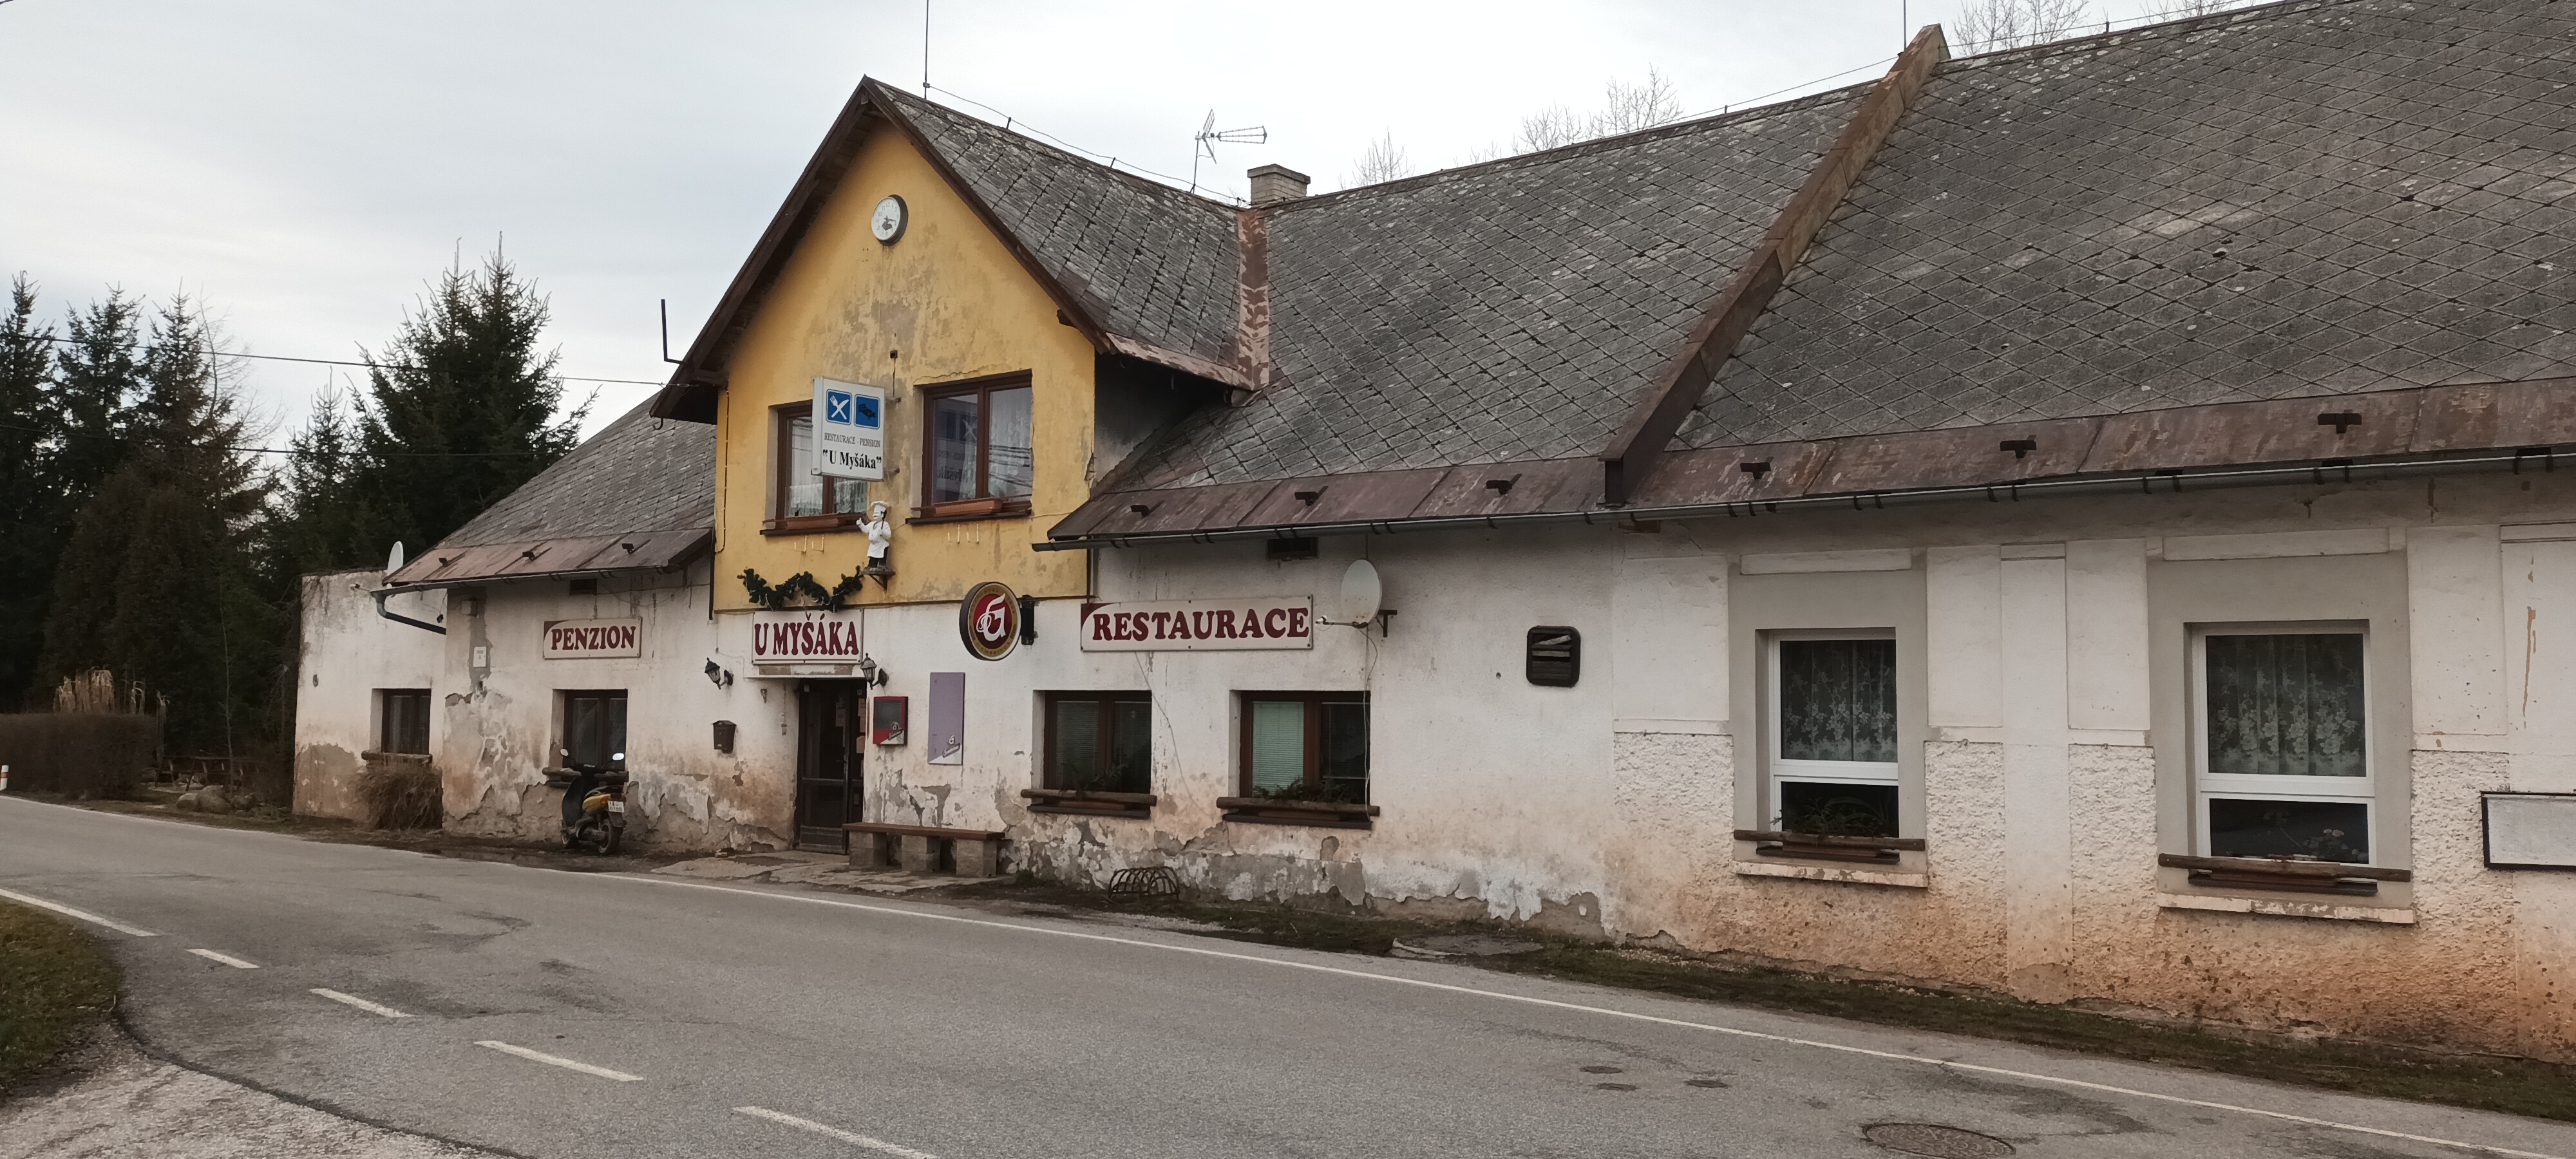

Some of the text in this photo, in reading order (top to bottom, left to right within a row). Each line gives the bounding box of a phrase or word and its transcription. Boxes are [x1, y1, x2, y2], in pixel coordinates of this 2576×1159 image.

[824, 432, 856, 444] RESTAURACE
[860, 438, 880, 448] PENSION
[551, 625, 636, 650] PENZION
[754, 612, 859, 655] U MYŠÁKA
[1092, 607, 1309, 641] RESTAURACE
